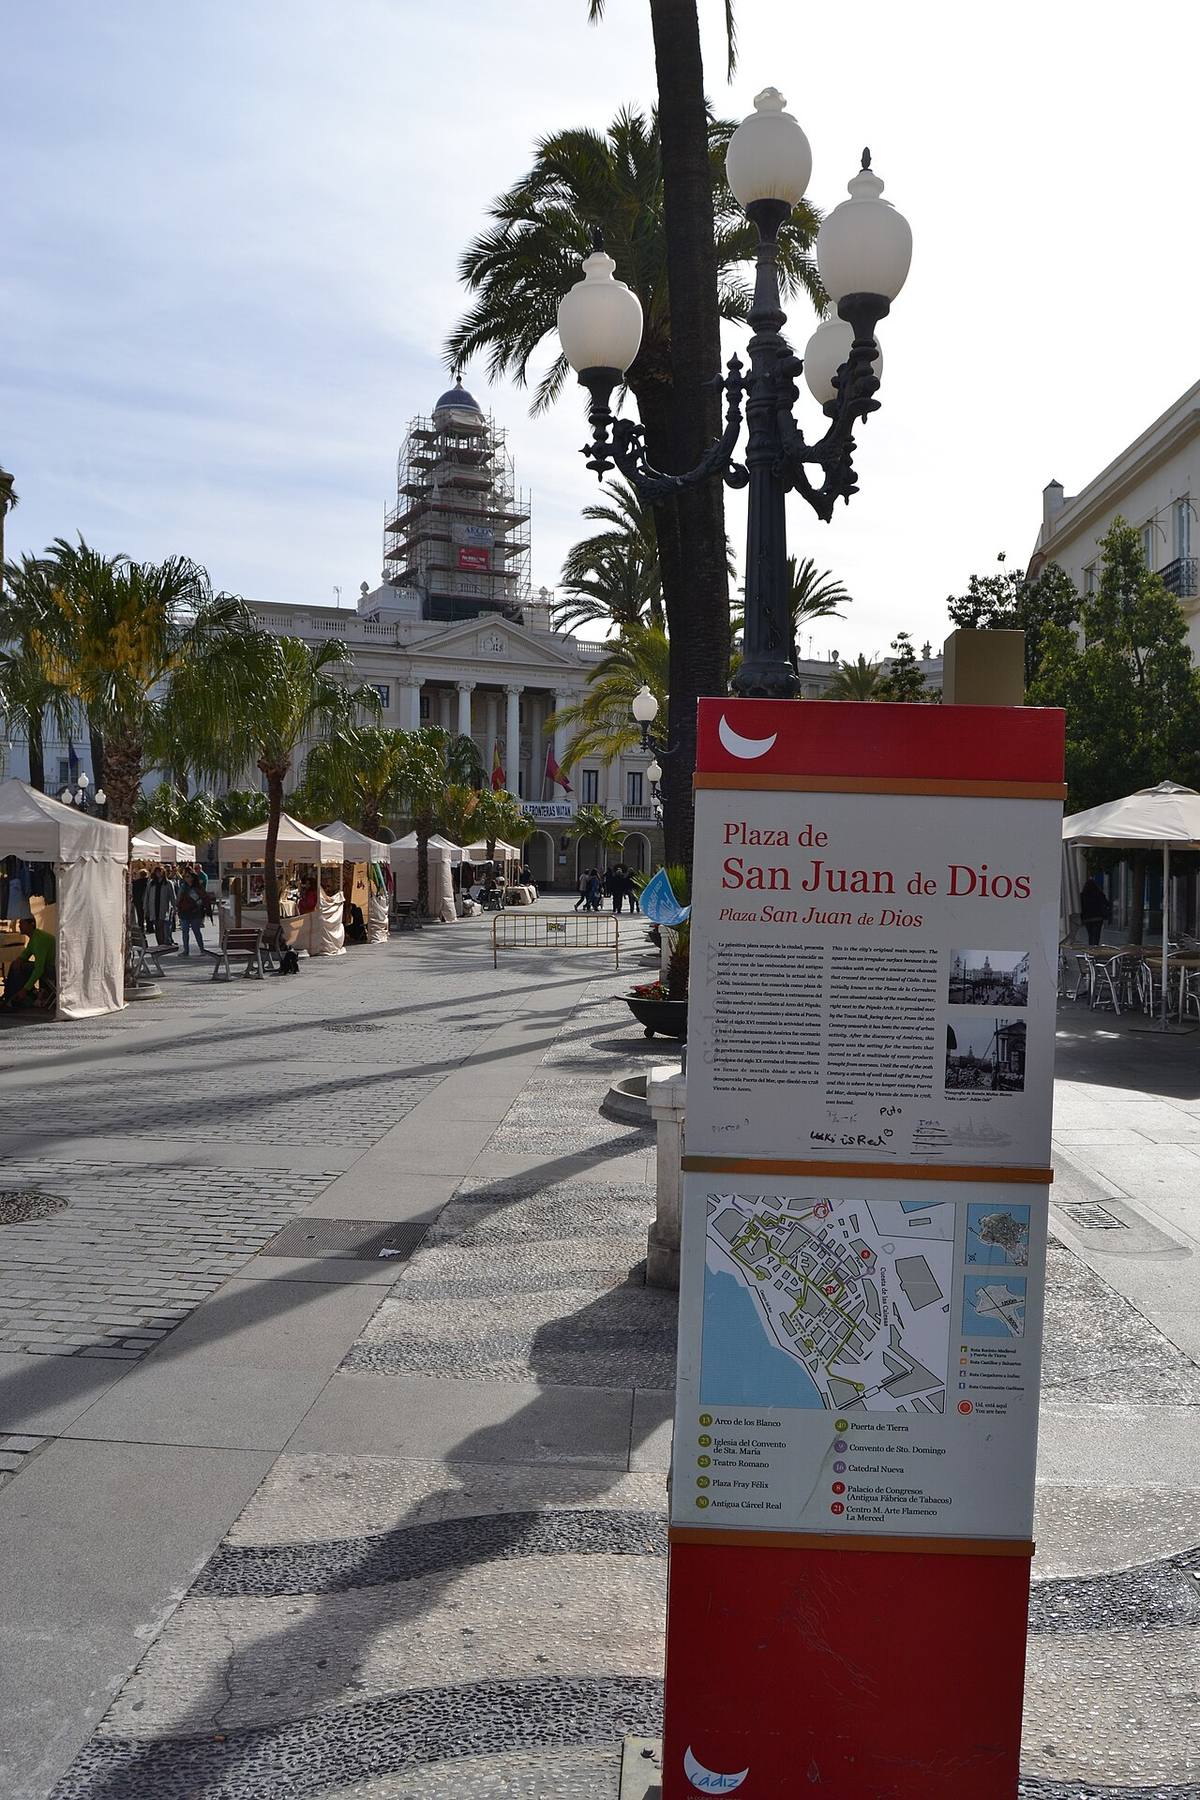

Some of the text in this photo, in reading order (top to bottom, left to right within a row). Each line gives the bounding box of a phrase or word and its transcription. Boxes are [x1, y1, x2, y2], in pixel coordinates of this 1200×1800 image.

[723, 823, 828, 848] Plaza de
[722, 857, 1032, 899] San Juan de Dios
[719, 905, 924, 928] Plaza San Juan de Dios
[714, 1439, 737, 1448] Iglesia
[913, 1447, 946, 1455] Domingo
[734, 1481, 749, 1489] Fray
[886, 1487, 923, 1495] Congresos
[712, 1500, 739, 1508] Antigua
[847, 1494, 878, 1502] (Antigua
[880, 1494, 907, 1503] Fábrica
[919, 1496, 952, 1505] Tabacos)
[691, 1773, 739, 1787] Cádiz
